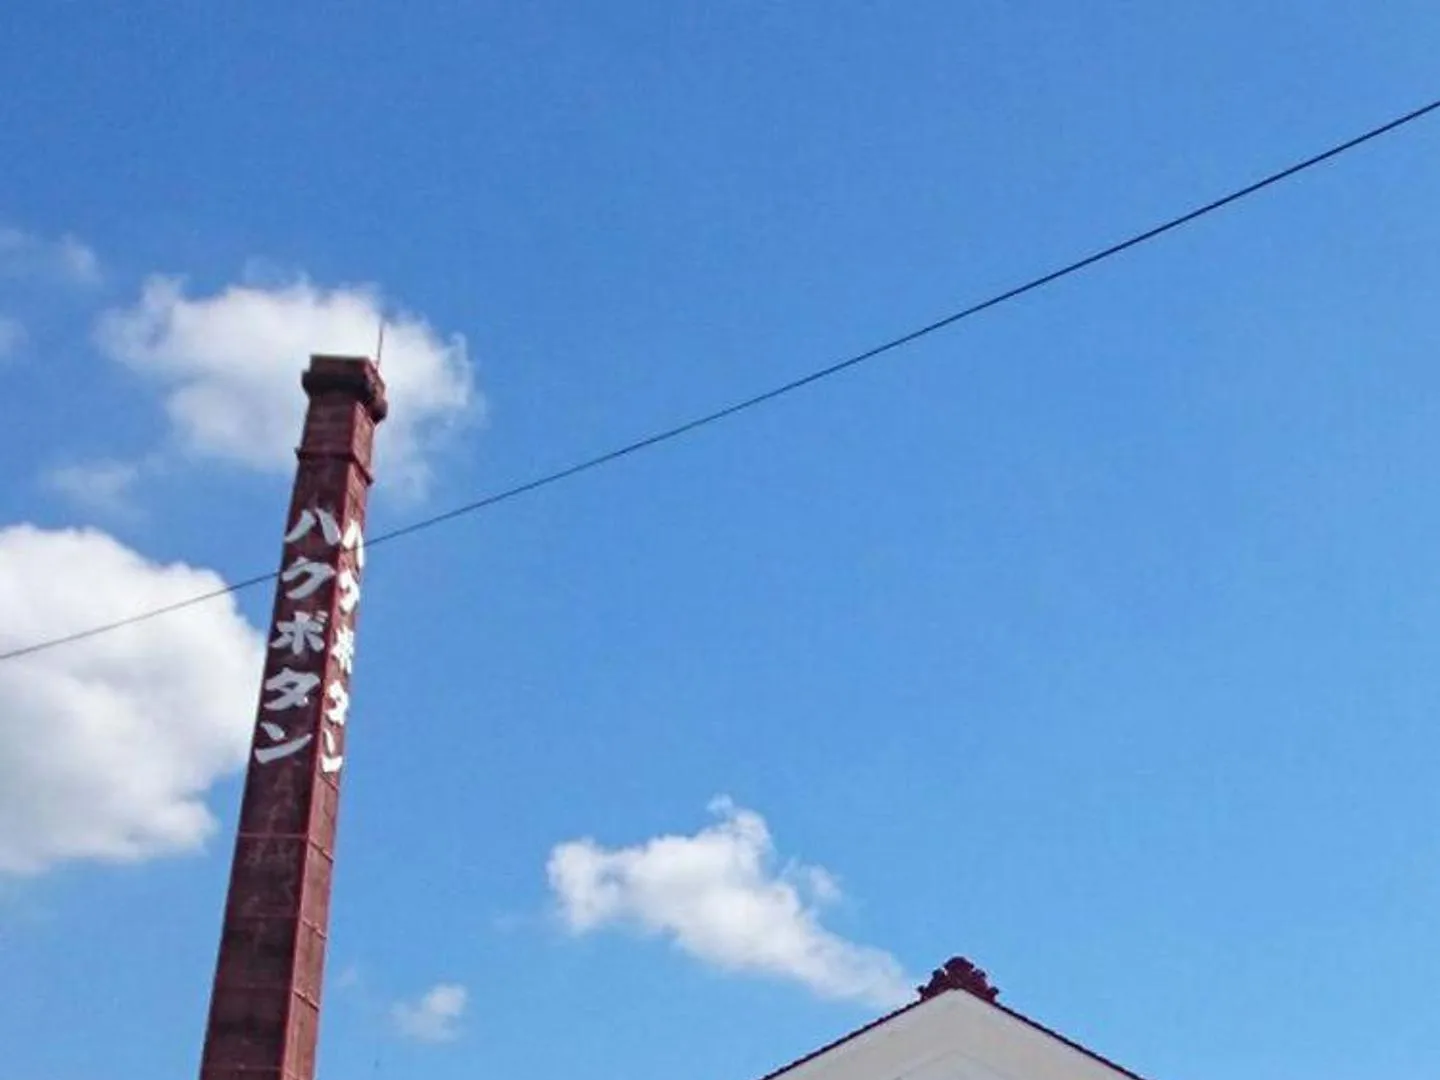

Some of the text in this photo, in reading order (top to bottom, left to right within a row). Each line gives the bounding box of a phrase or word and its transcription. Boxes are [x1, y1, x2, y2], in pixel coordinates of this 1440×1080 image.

[254, 508, 341, 764] ハクボタン
